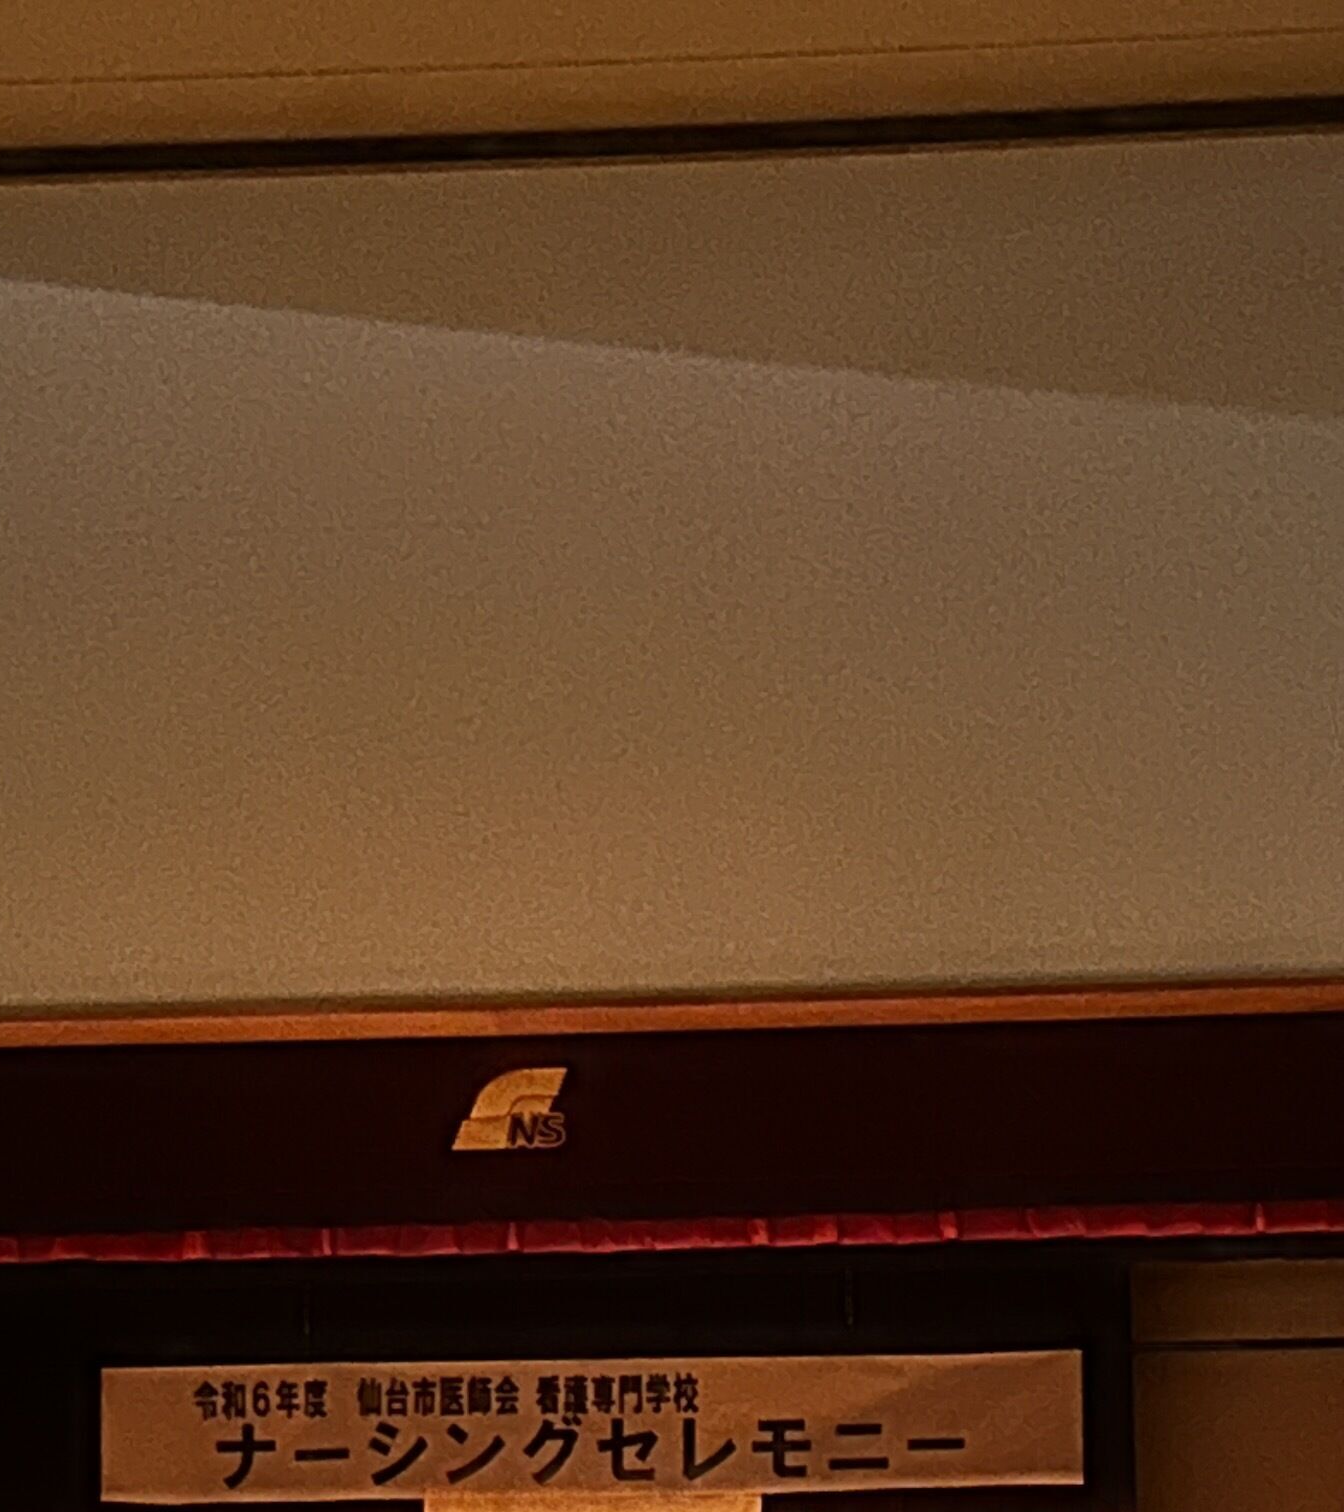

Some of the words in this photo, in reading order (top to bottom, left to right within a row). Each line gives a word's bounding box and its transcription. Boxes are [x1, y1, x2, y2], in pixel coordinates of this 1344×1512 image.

[508, 1111, 567, 1149] NS
[193, 1379, 329, 1420] 令和6年度
[357, 1374, 521, 1417] 仙台市医師会
[536, 1372, 700, 1415] 看護専門学校
[215, 1415, 966, 1490] ナーシングセレモニー
